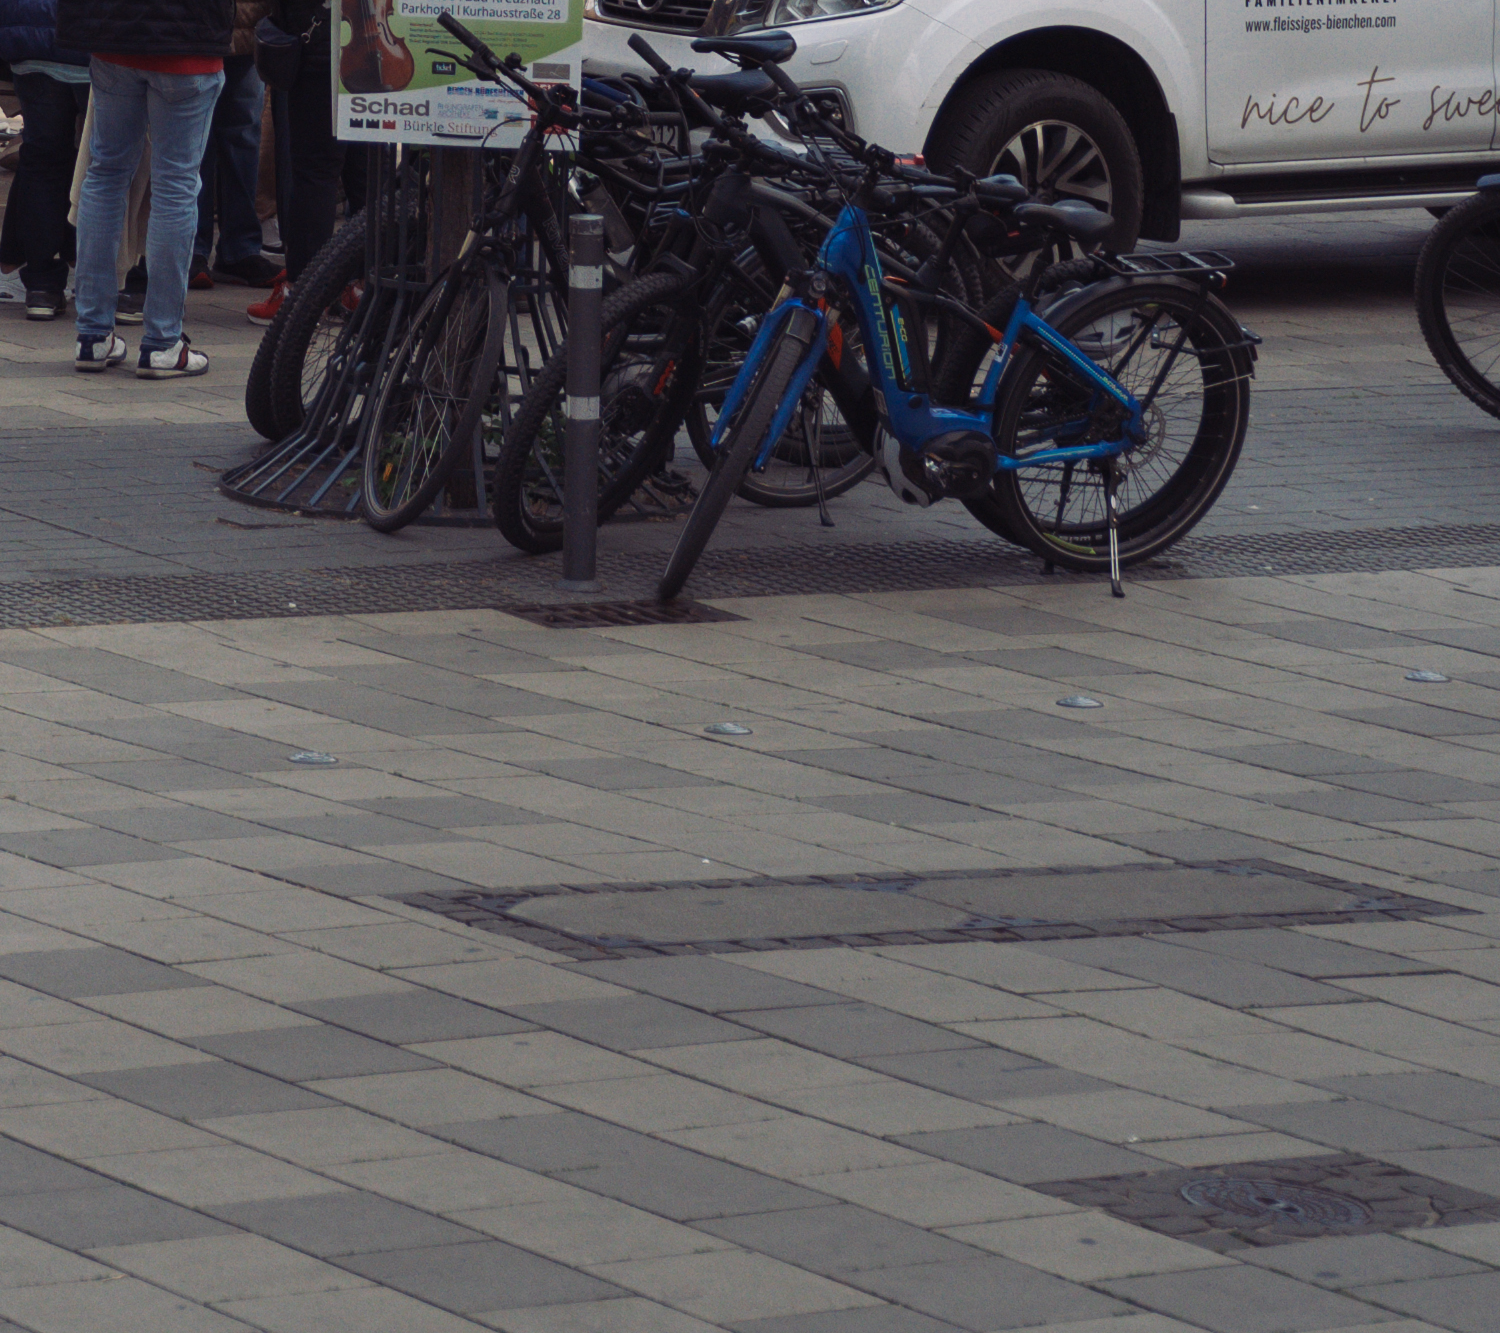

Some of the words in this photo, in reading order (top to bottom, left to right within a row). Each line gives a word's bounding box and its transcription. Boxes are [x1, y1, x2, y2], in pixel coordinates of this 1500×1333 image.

[401, 2, 454, 16] Parkhotel
[463, 6, 544, 19] Kurhausstraße
[547, 9, 561, 21] 28
[1245, 13, 1396, 33] www.fleissiges-bienchen.com
[350, 96, 430, 117] Schad
[1241, 93, 1335, 129] nice
[1357, 65, 1401, 132] to
[403, 119, 444, 133] Bürkle
[447, 121, 498, 137] Stiftung
[864, 264, 896, 380] CENTURION
